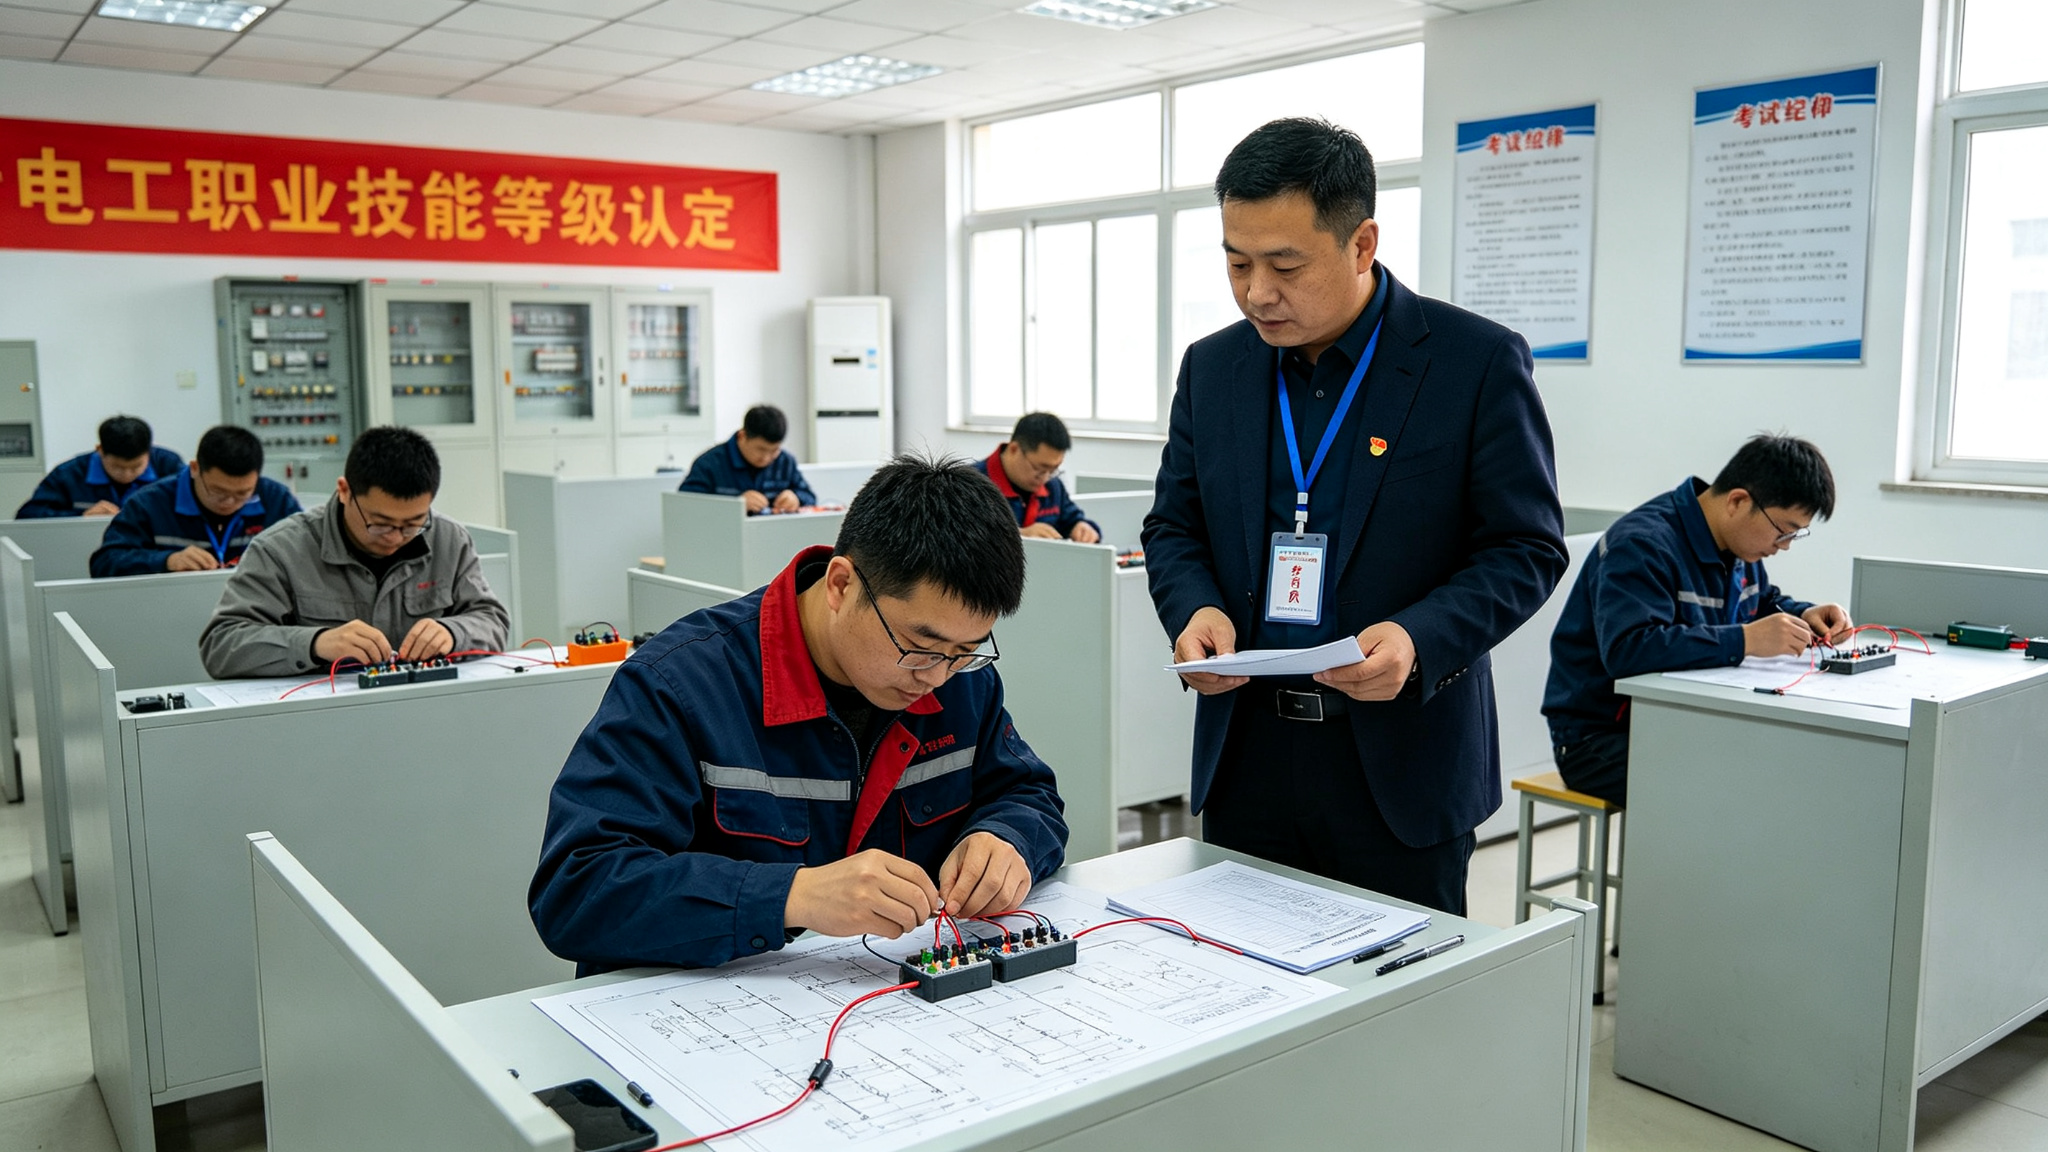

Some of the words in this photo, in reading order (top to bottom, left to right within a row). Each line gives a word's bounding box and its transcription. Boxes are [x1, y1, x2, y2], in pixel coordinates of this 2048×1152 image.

[0, 146, 736, 250] 电工职业技能等级认定
